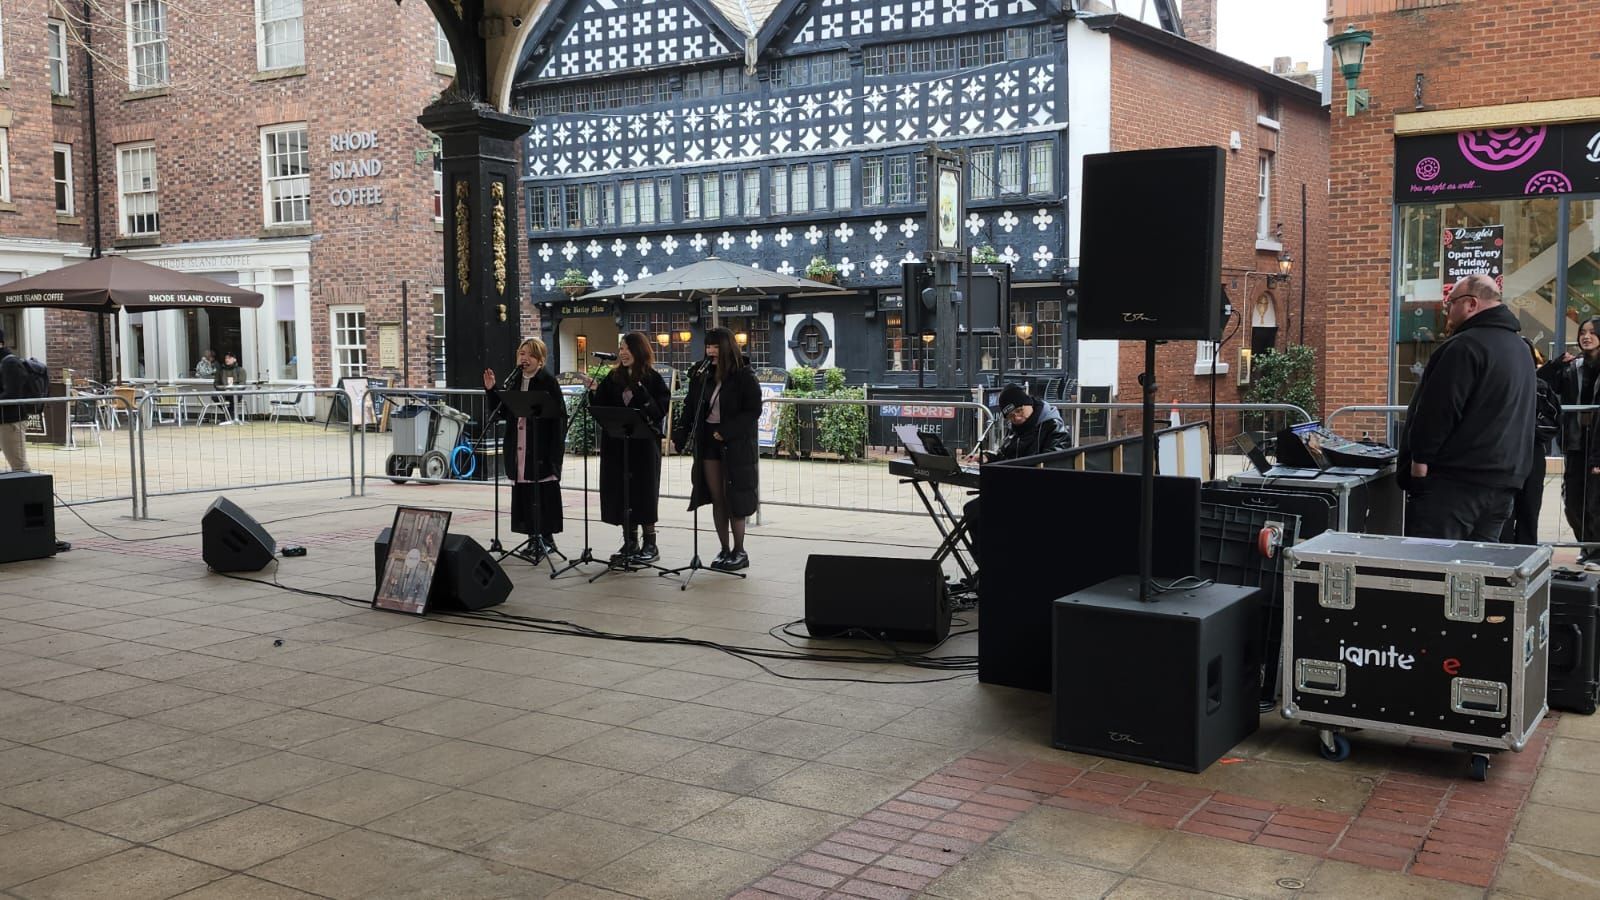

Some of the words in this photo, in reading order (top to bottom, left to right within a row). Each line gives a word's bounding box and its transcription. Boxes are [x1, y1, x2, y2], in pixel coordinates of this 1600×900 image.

[330, 129, 379, 152] RHODE
[329, 158, 382, 180] ISLAND
[1410, 184, 1422, 192] You
[1424, 182, 1446, 194] might
[330, 185, 383, 207] COFFEE
[1447, 251, 1473, 260] Open
[1474, 249, 1500, 259] Every
[159, 258, 185, 269] RHODE
[188, 256, 218, 268] ISLAND
[220, 255, 251, 266] COFFEE
[1458, 258, 1490, 268] Friday,
[1448, 266, 1491, 276] Saturday
[1491, 266, 1499, 274] &
[6, 294, 23, 303] RHODE
[23, 293, 42, 302] ISLAND
[43, 292, 64, 302] COFFEE
[148, 294, 176, 302] RHODE
[177, 294, 203, 303] ISLAND
[205, 295, 232, 304] COFFEE
[740, 304, 753, 312] Pub
[881, 404, 901, 416] sky
[903, 405, 954, 416] SPORTS
[917, 424, 942, 433] HERE
